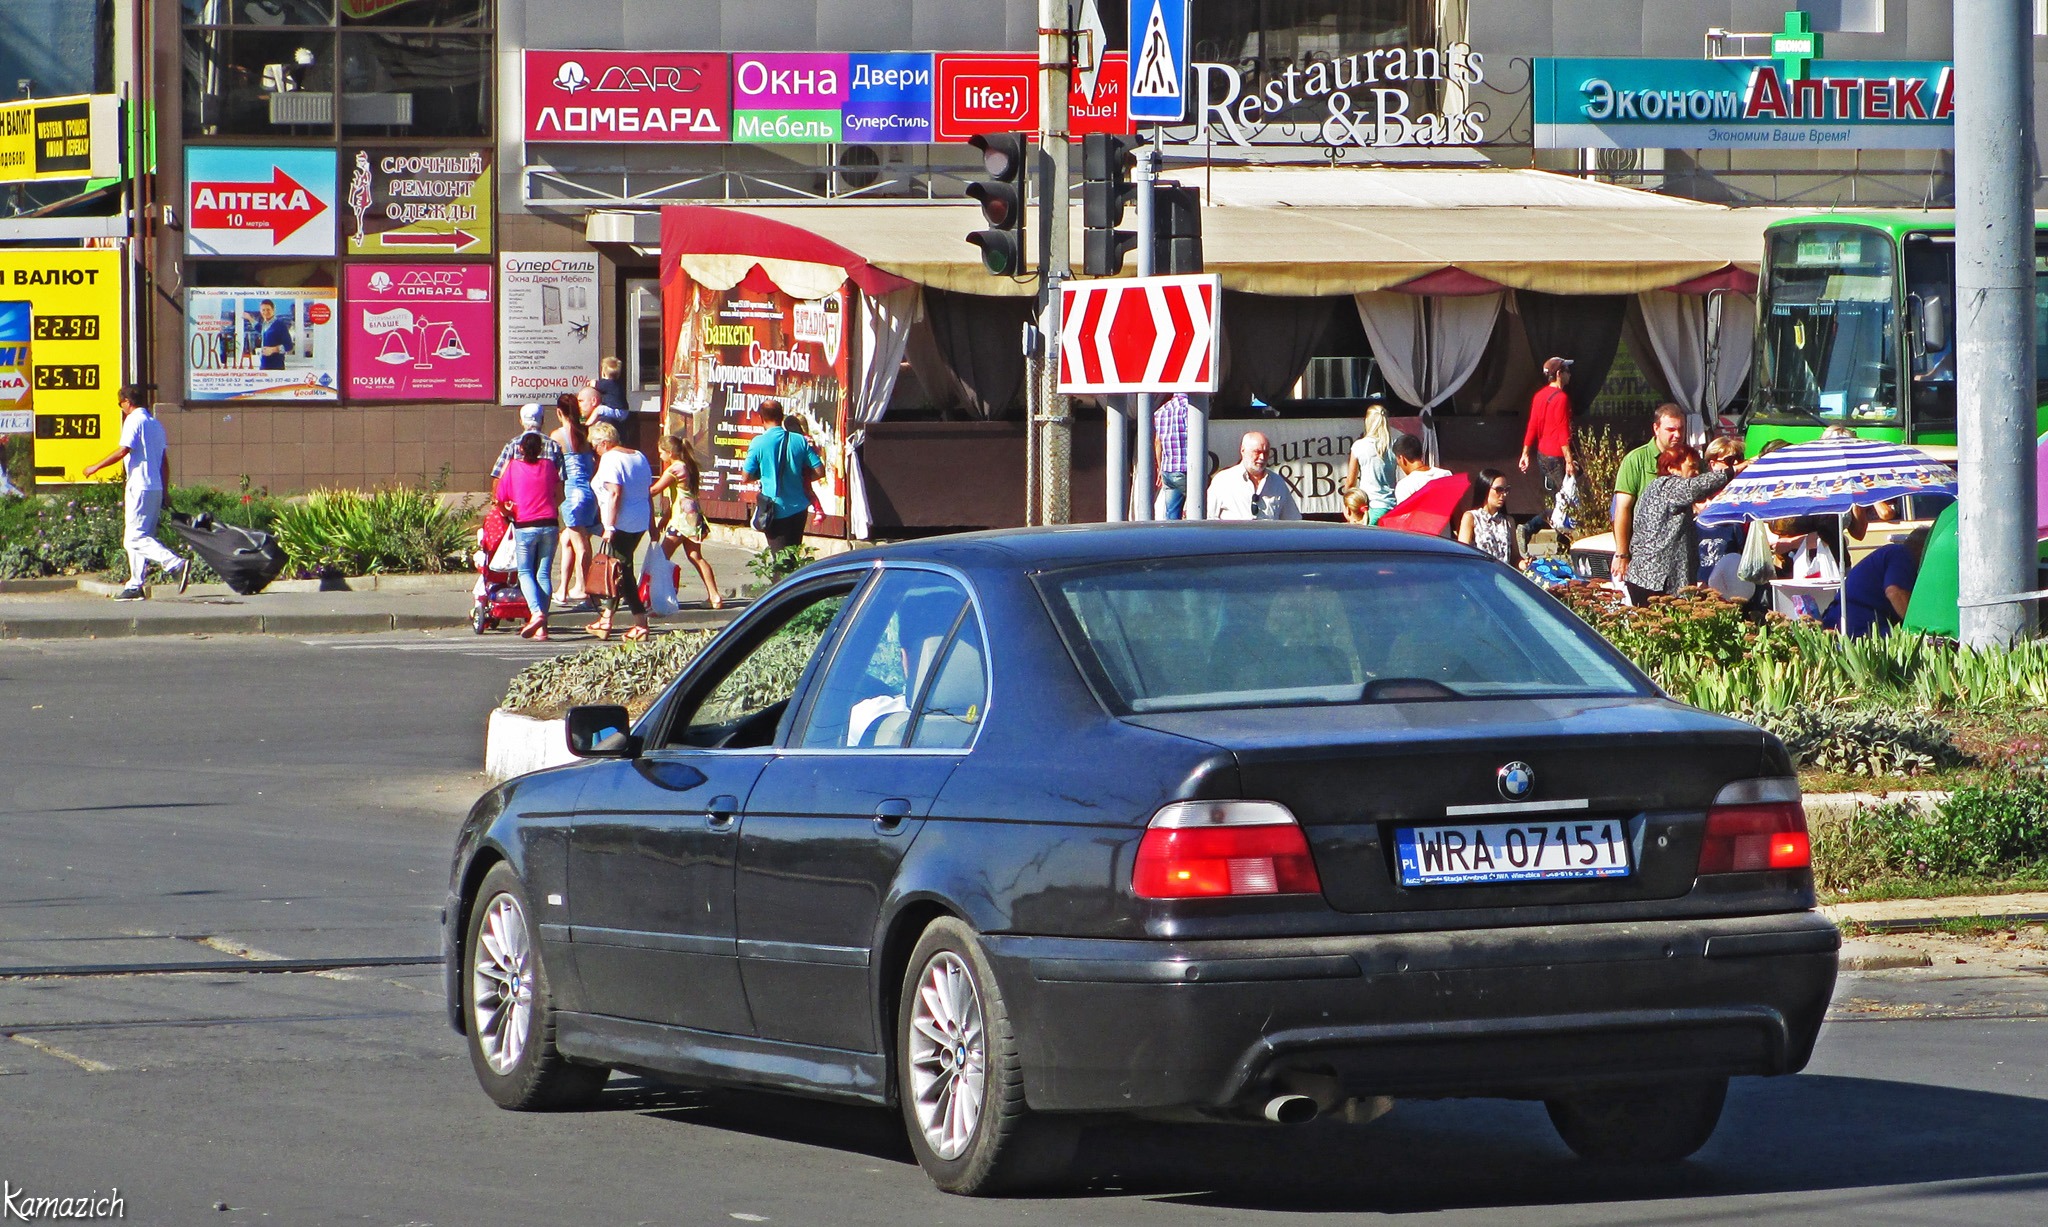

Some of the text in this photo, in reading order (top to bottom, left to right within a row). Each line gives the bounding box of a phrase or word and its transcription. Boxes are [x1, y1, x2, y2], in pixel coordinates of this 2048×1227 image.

[737, 60, 838, 95] Окна
[852, 63, 930, 91] Двери
[964, 86, 1019, 114] life:)
[1189, 41, 1485, 147] Restaurants
[6, 108, 32, 137] ВАЛЮТ
[37, 120, 64, 139] WESTERN
[535, 107, 721, 132] ЛОМБАРД
[738, 115, 833, 138] Мебель
[845, 114, 930, 131] СуперСтиль
[1707, 128, 1851, 145] Экономим Ваше Время!
[46, 140, 64, 158] UNION
[380, 152, 482, 175] СРОЧНЫЙ
[388, 179, 475, 197] РЕМОНТ
[226, 213, 243, 227] 10
[385, 202, 478, 223] ОДЕЖДЫ
[505, 258, 595, 273] СуперСтиль
[14, 269, 99, 286] ВАЛЮТ
[508, 274, 592, 284] Окна Двери Мебель
[397, 287, 464, 296] ЛОМБАРД
[37, 318, 96, 338] 22.90
[704, 316, 755, 346] Банкеты
[190, 332, 254, 370] ОКНА
[748, 340, 811, 375] Свадьбы
[37, 367, 96, 387] 25.70
[352, 376, 396, 385] ПОЗИКА
[510, 375, 591, 390] Рассрочка 0%
[707, 357, 776, 391] Корпоративы
[506, 391, 568, 400] www.superstyl
[724, 385, 745, 417] Дни
[54, 416, 97, 437] 3.40
[1418, 823, 1618, 873] WRA 07151
[1402, 858, 1417, 870] PL
